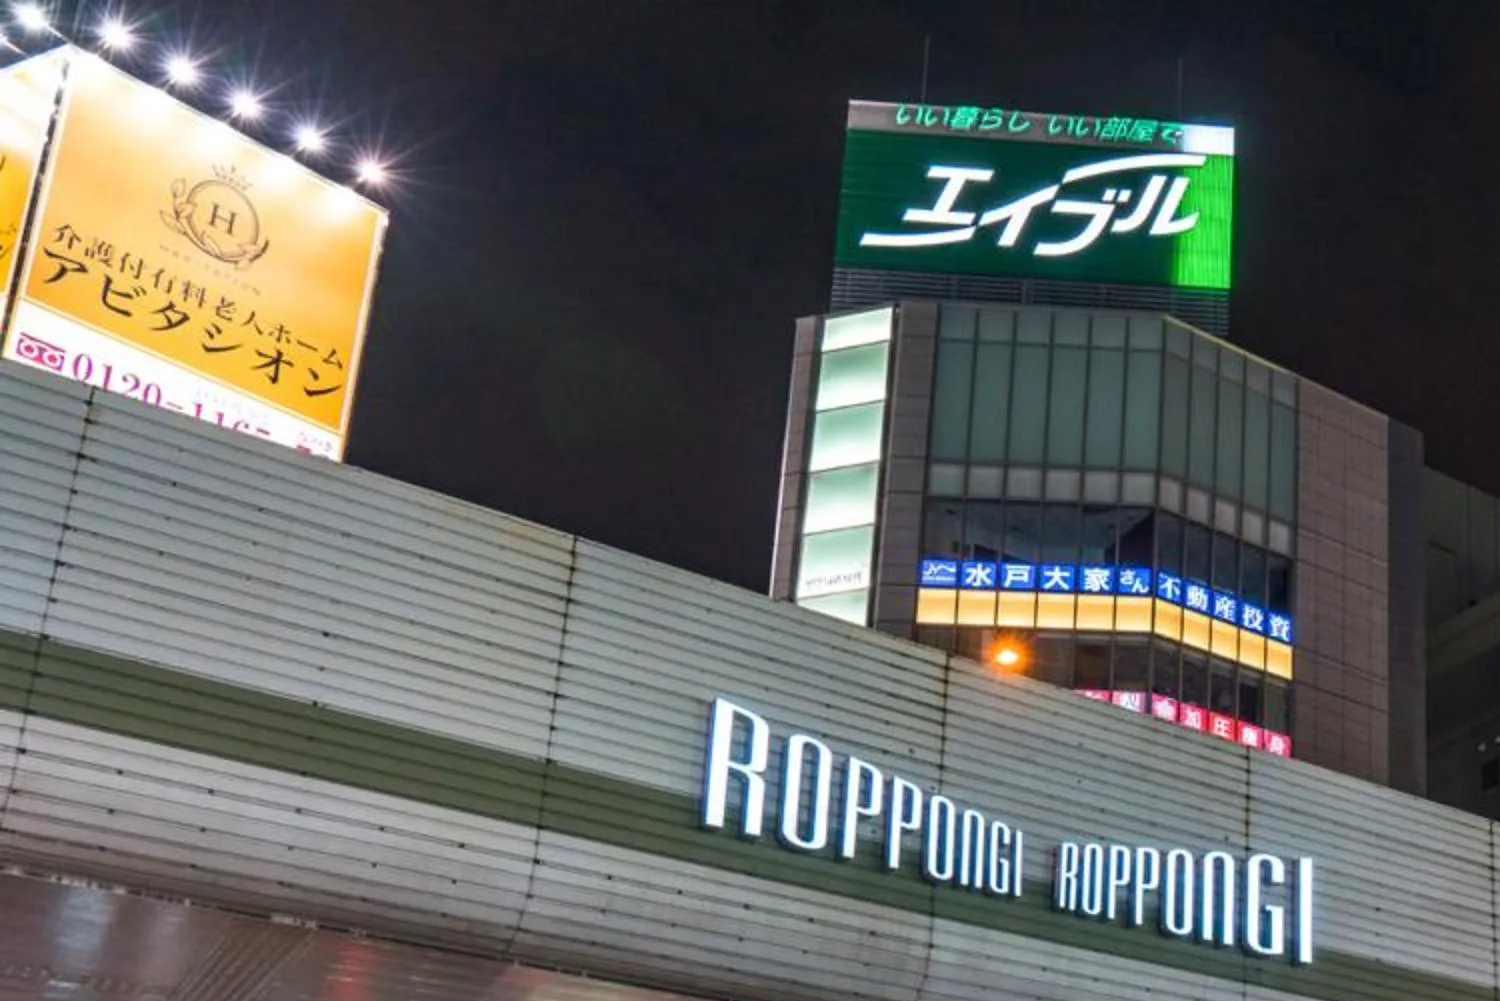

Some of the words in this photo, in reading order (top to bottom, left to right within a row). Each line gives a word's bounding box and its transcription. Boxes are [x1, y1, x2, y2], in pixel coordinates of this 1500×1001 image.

[895, 102, 1032, 133] いい暮らし
[208, 203, 239, 238] H
[859, 152, 1207, 257] エイブル
[42, 247, 344, 399] アビタシオン
[54, 223, 345, 371] 介護付有料老人ホーム
[965, 564, 1150, 594] 水戸大家さん
[1158, 573, 1292, 642] 不動産投資
[704, 696, 1024, 898] ROPPONGI
[1053, 840, 1314, 964] ROPPONGI
